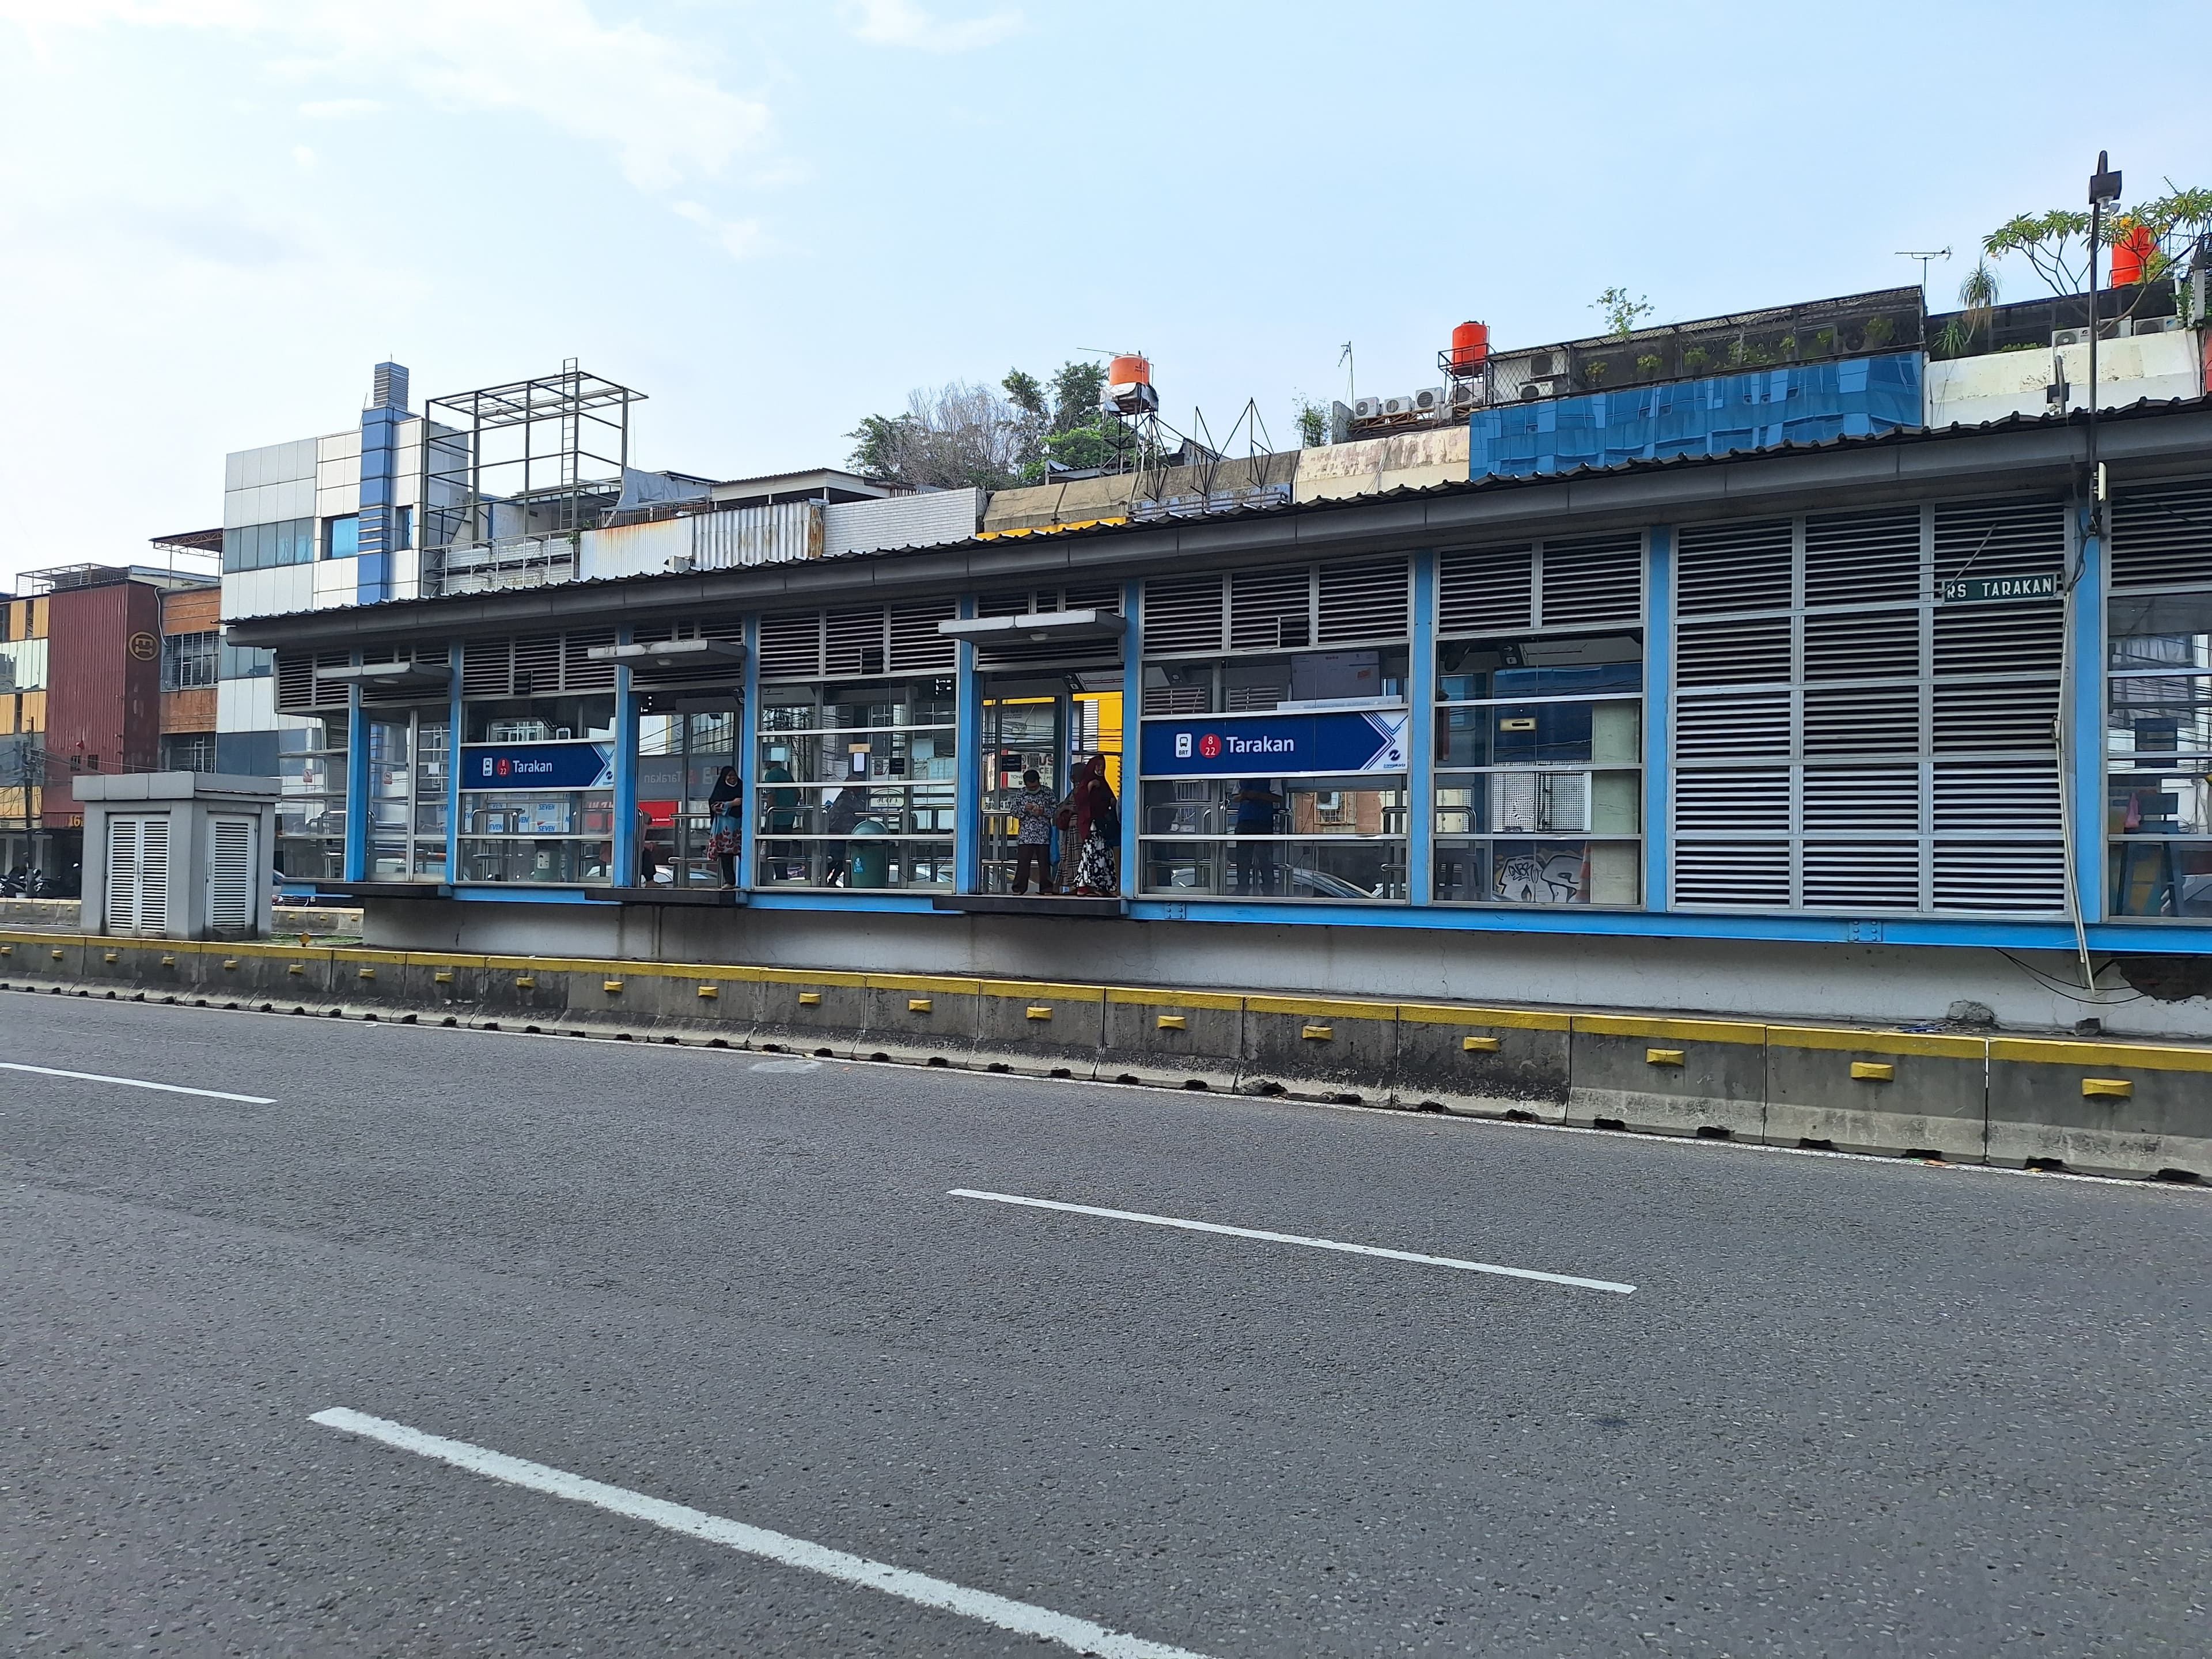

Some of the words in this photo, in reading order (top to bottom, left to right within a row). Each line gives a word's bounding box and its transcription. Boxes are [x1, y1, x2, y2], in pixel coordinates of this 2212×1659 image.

[1947, 584, 1967, 599] RS
[1982, 578, 2051, 597] TARAKAN
[1208, 736, 1213, 745] 8
[1226, 736, 1294, 753] Tarakan
[1205, 747, 1215, 756] 22
[513, 760, 552, 773] Tarakan
